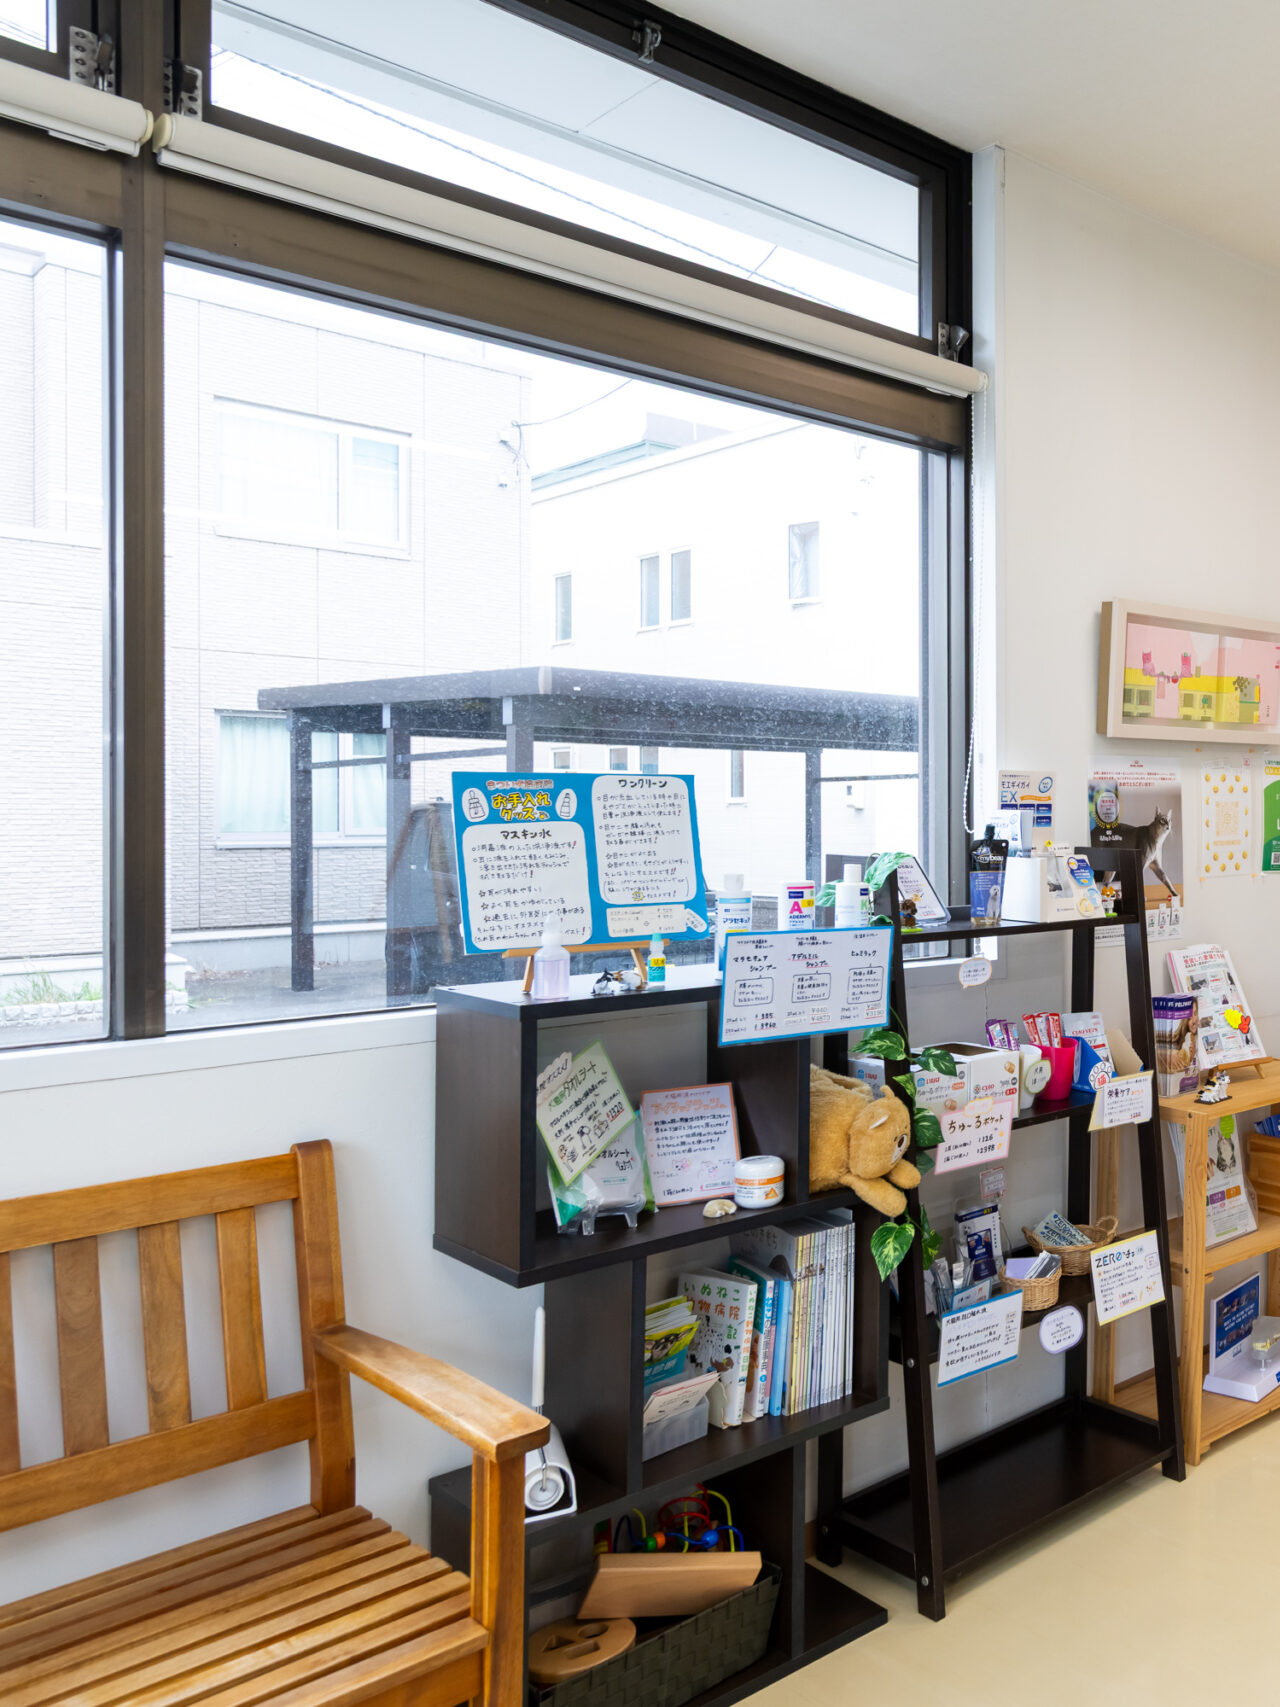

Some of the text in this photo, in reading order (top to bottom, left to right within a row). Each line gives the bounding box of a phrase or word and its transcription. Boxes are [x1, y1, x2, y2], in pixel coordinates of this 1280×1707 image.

[618, 778, 668, 789] ワンクリーン
[492, 791, 551, 809] お手入れ
[1000, 790, 1018, 803] EX
[500, 806, 537, 821] グッズ
[500, 828, 552, 840] マスキン水
[789, 900, 804, 915] A
[732, 955, 768, 963] マラセキュア
[750, 964, 777, 973] シャンプー
[683, 1282, 741, 1302] いぬねこ
